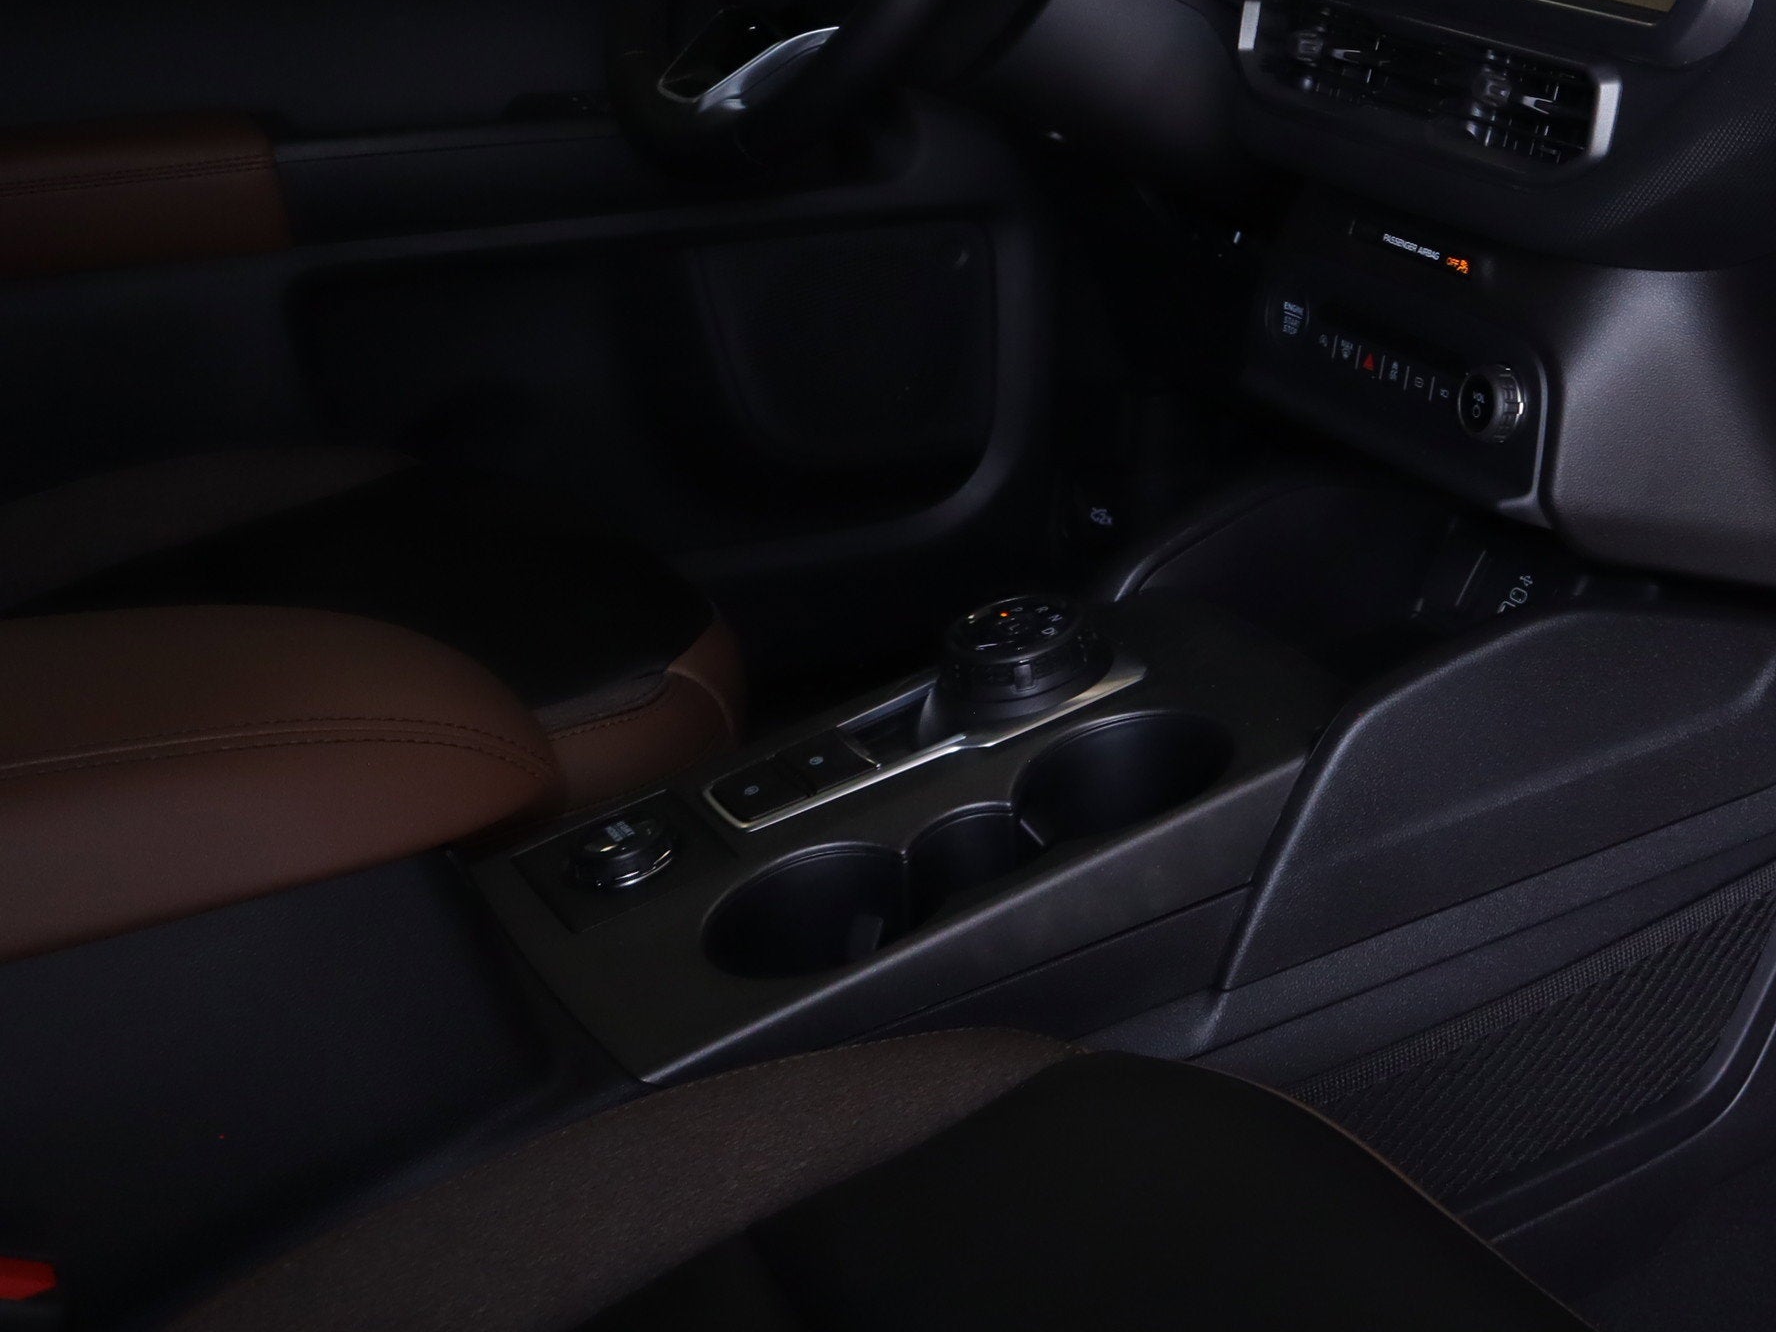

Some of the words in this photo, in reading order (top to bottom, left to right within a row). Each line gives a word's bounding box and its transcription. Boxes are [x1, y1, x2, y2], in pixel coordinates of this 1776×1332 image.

[1383, 233, 1418, 253] PASSENGER
[1417, 246, 1440, 261] AIRBAG
[1446, 256, 1460, 268] OFF
